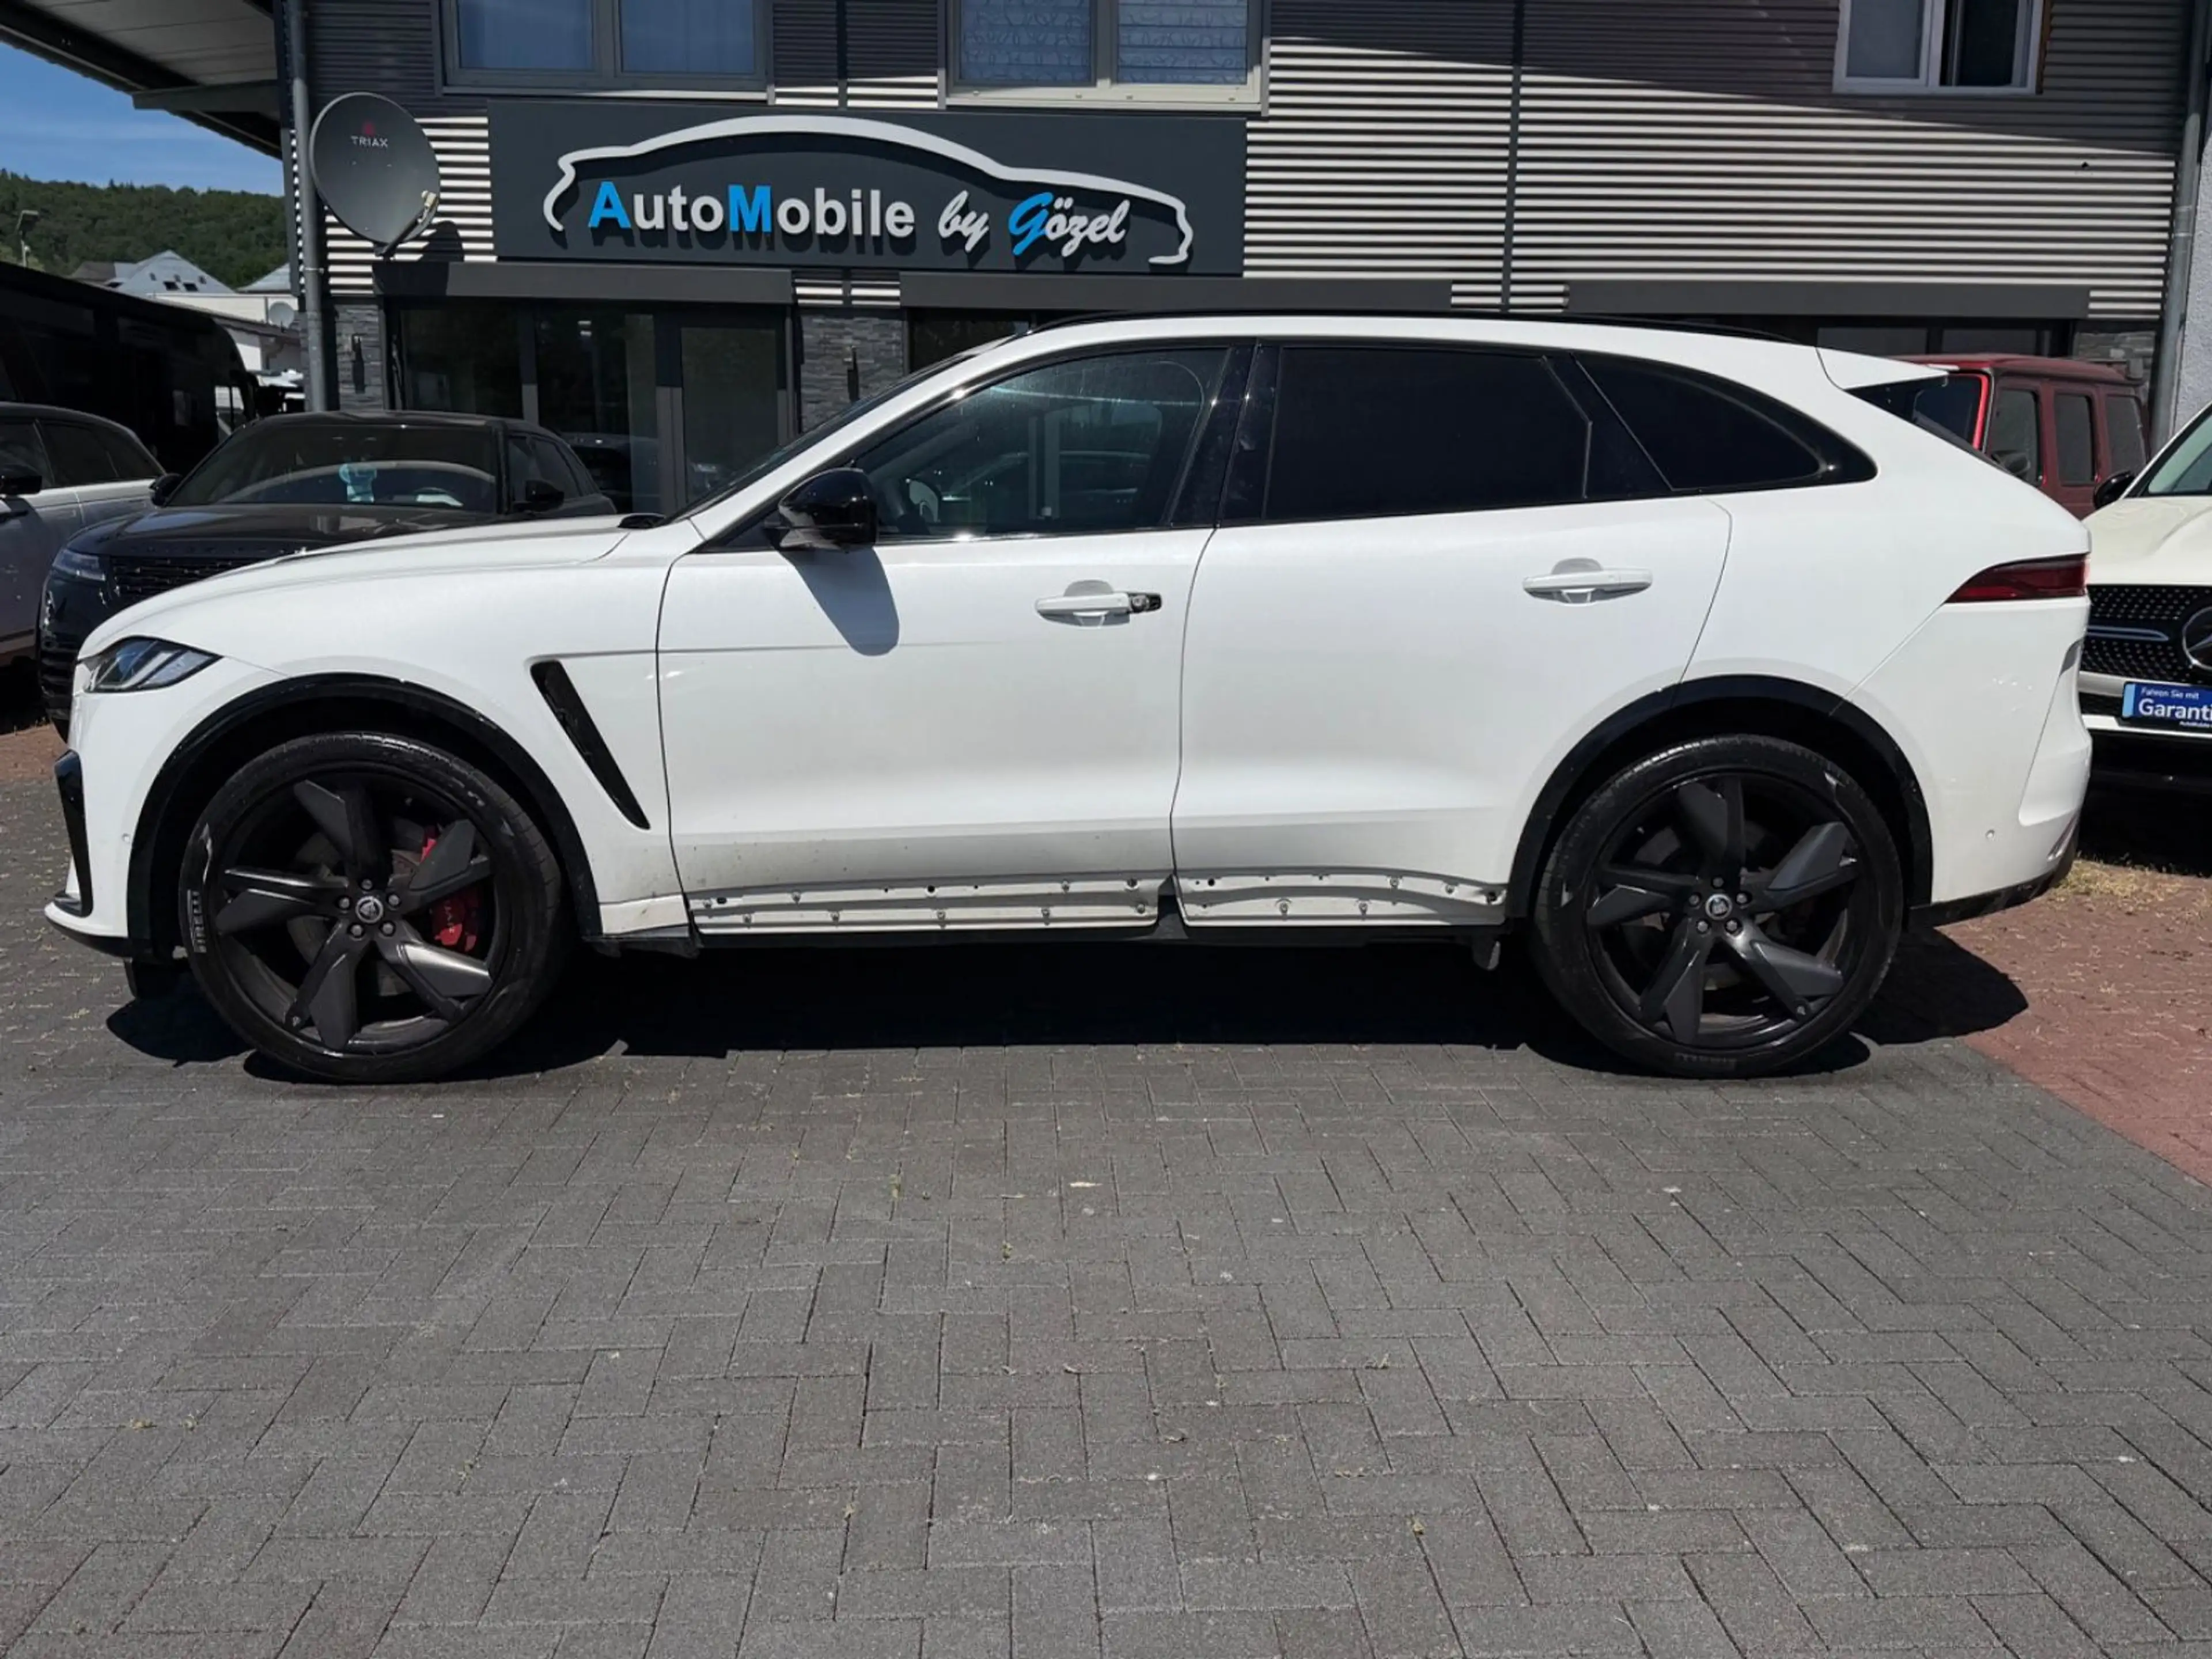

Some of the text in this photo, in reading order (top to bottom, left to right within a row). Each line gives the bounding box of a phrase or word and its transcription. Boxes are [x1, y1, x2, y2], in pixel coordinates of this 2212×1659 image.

[350, 135, 388, 147] TRIAX
[588, 181, 1130, 257] AutoMobile by Gözel
